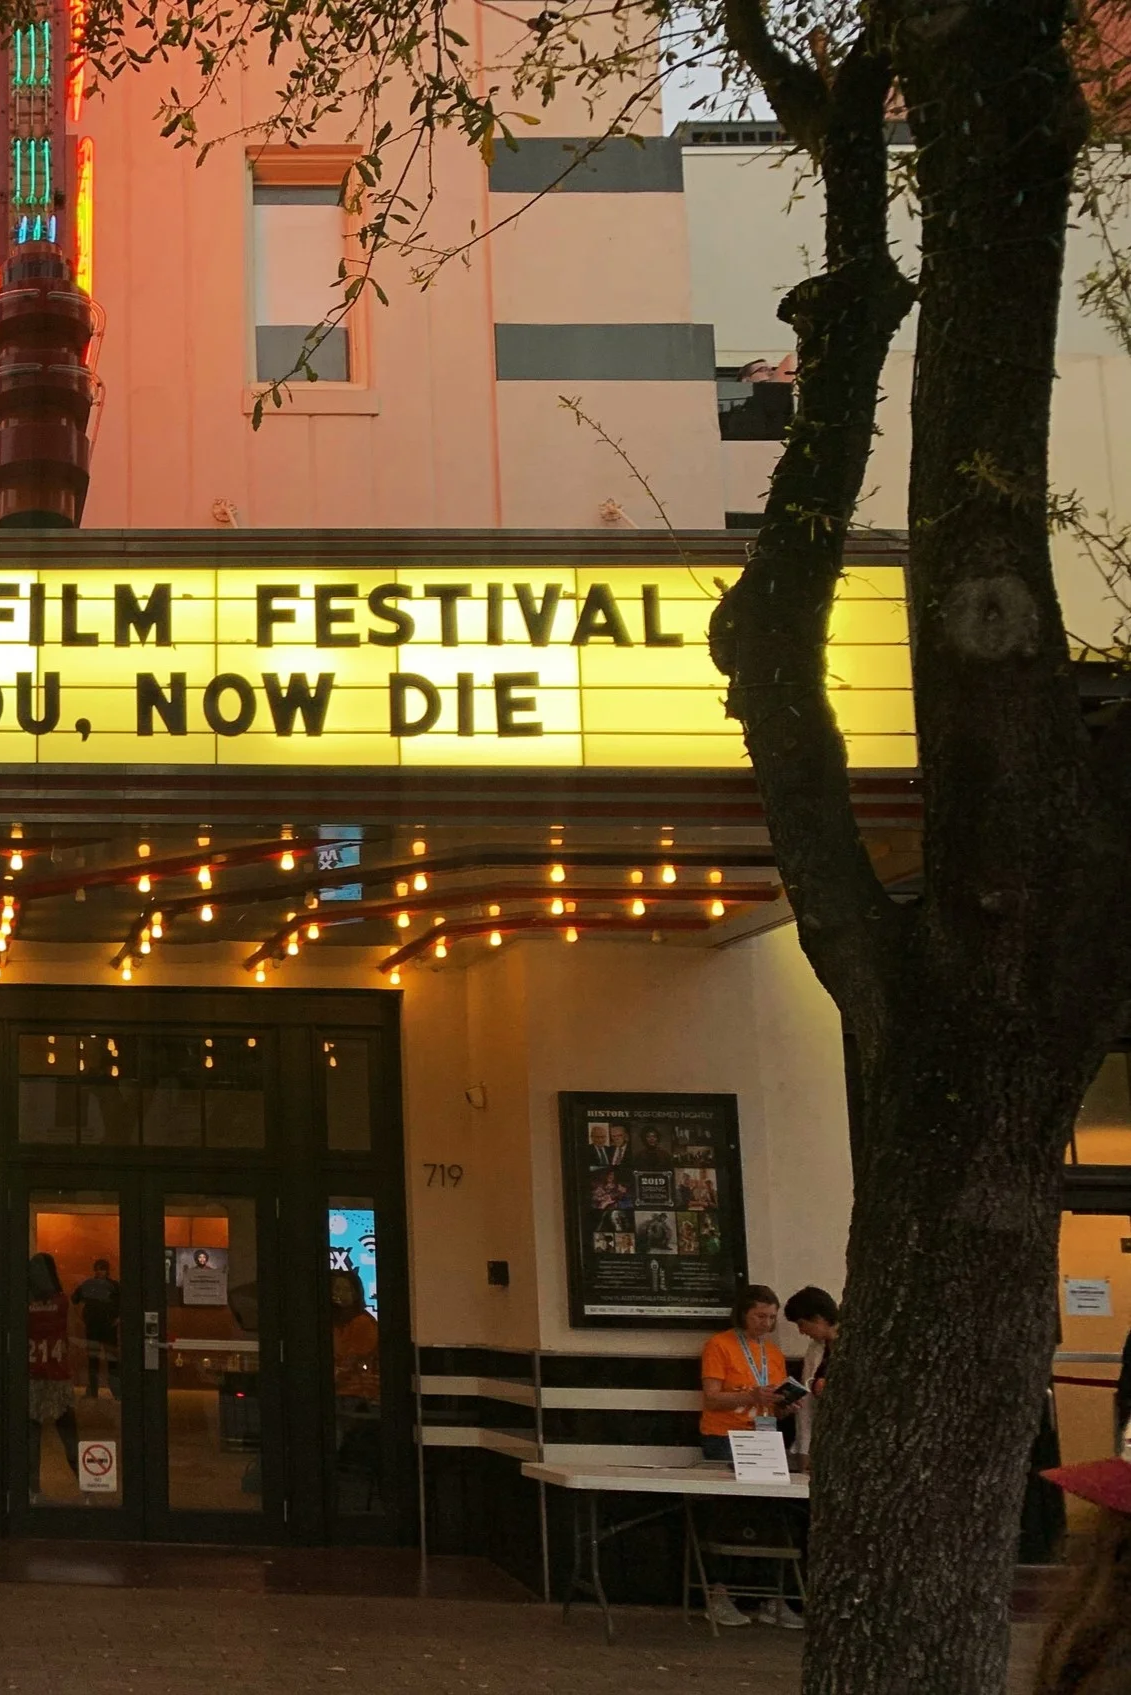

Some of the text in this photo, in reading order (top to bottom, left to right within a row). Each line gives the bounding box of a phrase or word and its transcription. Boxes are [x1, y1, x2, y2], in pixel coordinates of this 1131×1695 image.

[253, 583, 684, 648] FESTIVAL
[136, 671, 337, 738] NOW
[388, 671, 544, 738] DIE
[423, 1163, 464, 1188] 719
[641, 1177, 666, 1186] 2019
